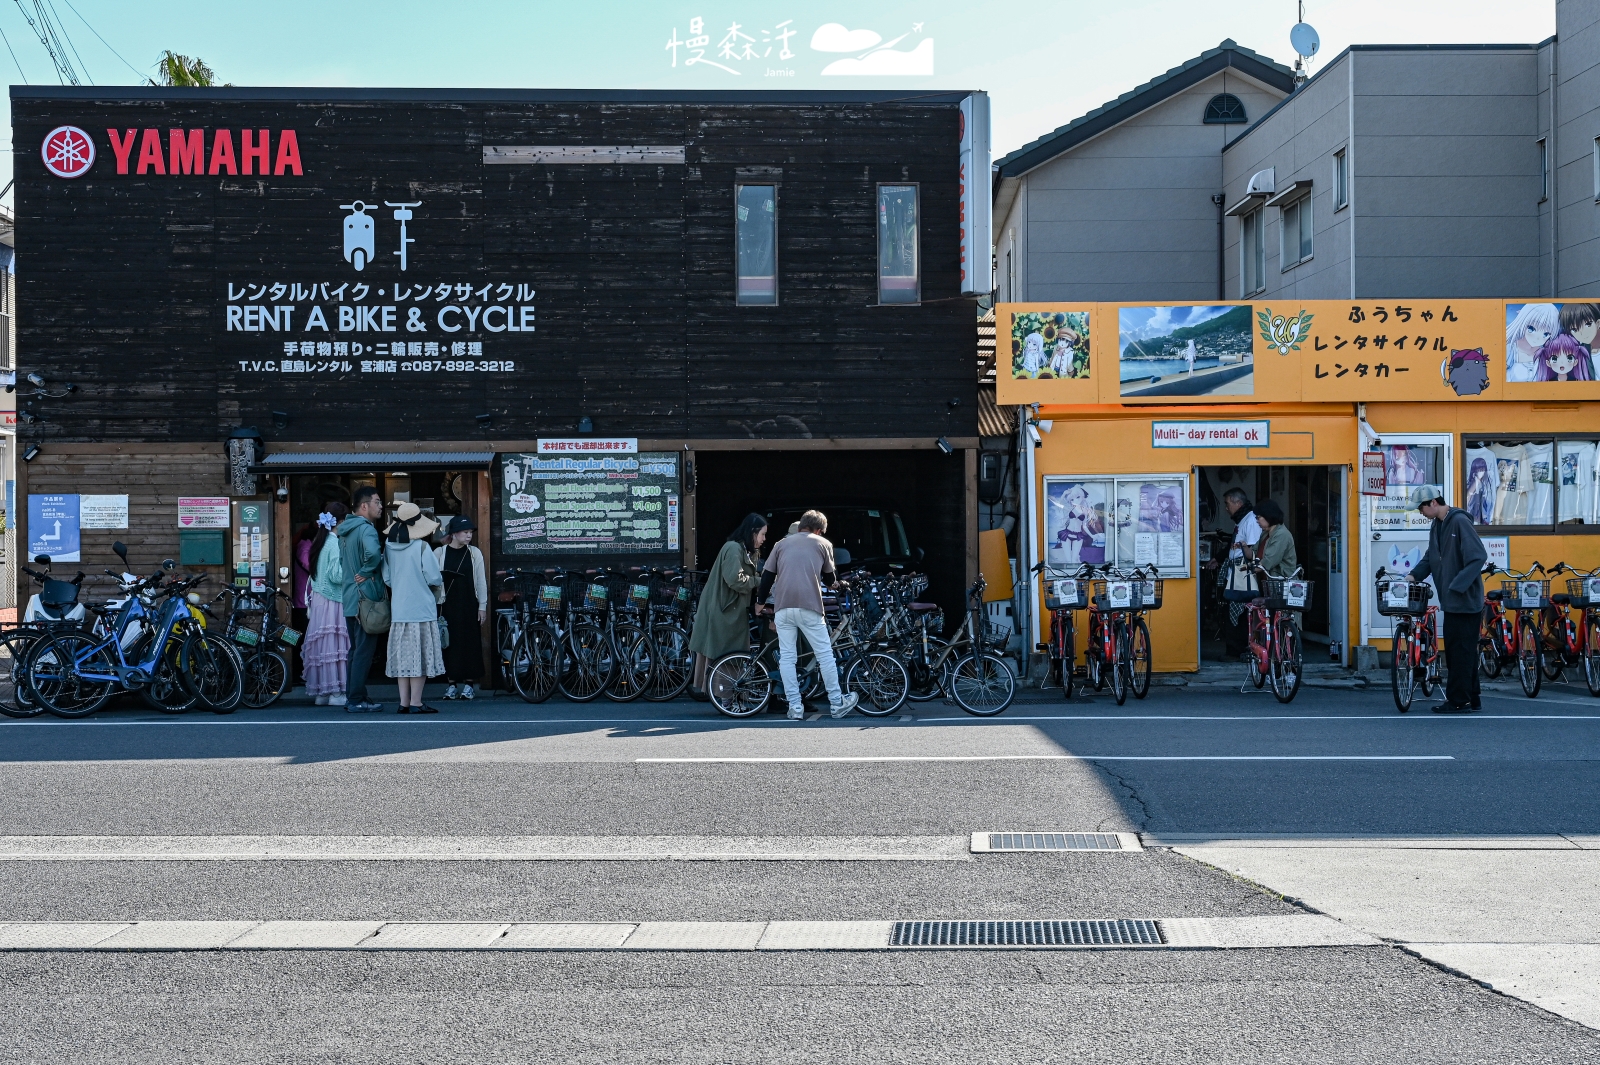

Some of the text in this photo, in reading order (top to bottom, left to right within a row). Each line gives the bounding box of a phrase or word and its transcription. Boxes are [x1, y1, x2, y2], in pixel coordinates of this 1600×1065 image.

[107, 129, 303, 175] YAMAHA
[228, 282, 536, 302] レンタルバイク・レンタサイクル
[226, 305, 536, 333] RENT A BIKE & CYCLE
[1349, 305, 1458, 323] ふうちゃん
[1314, 335, 1448, 352] レンタサイクル
[1315, 363, 1410, 379] レンタカー
[1209, 428, 1238, 439] rental
[1244, 428, 1259, 440] ok
[532, 458, 638, 472] Rental Regular Bicycle
[546, 484, 570, 492] Rental
[571, 484, 596, 492] Electric
[632, 487, 661, 496] ¥1,500
[546, 501, 569, 509] Rental
[571, 501, 594, 512] Sports
